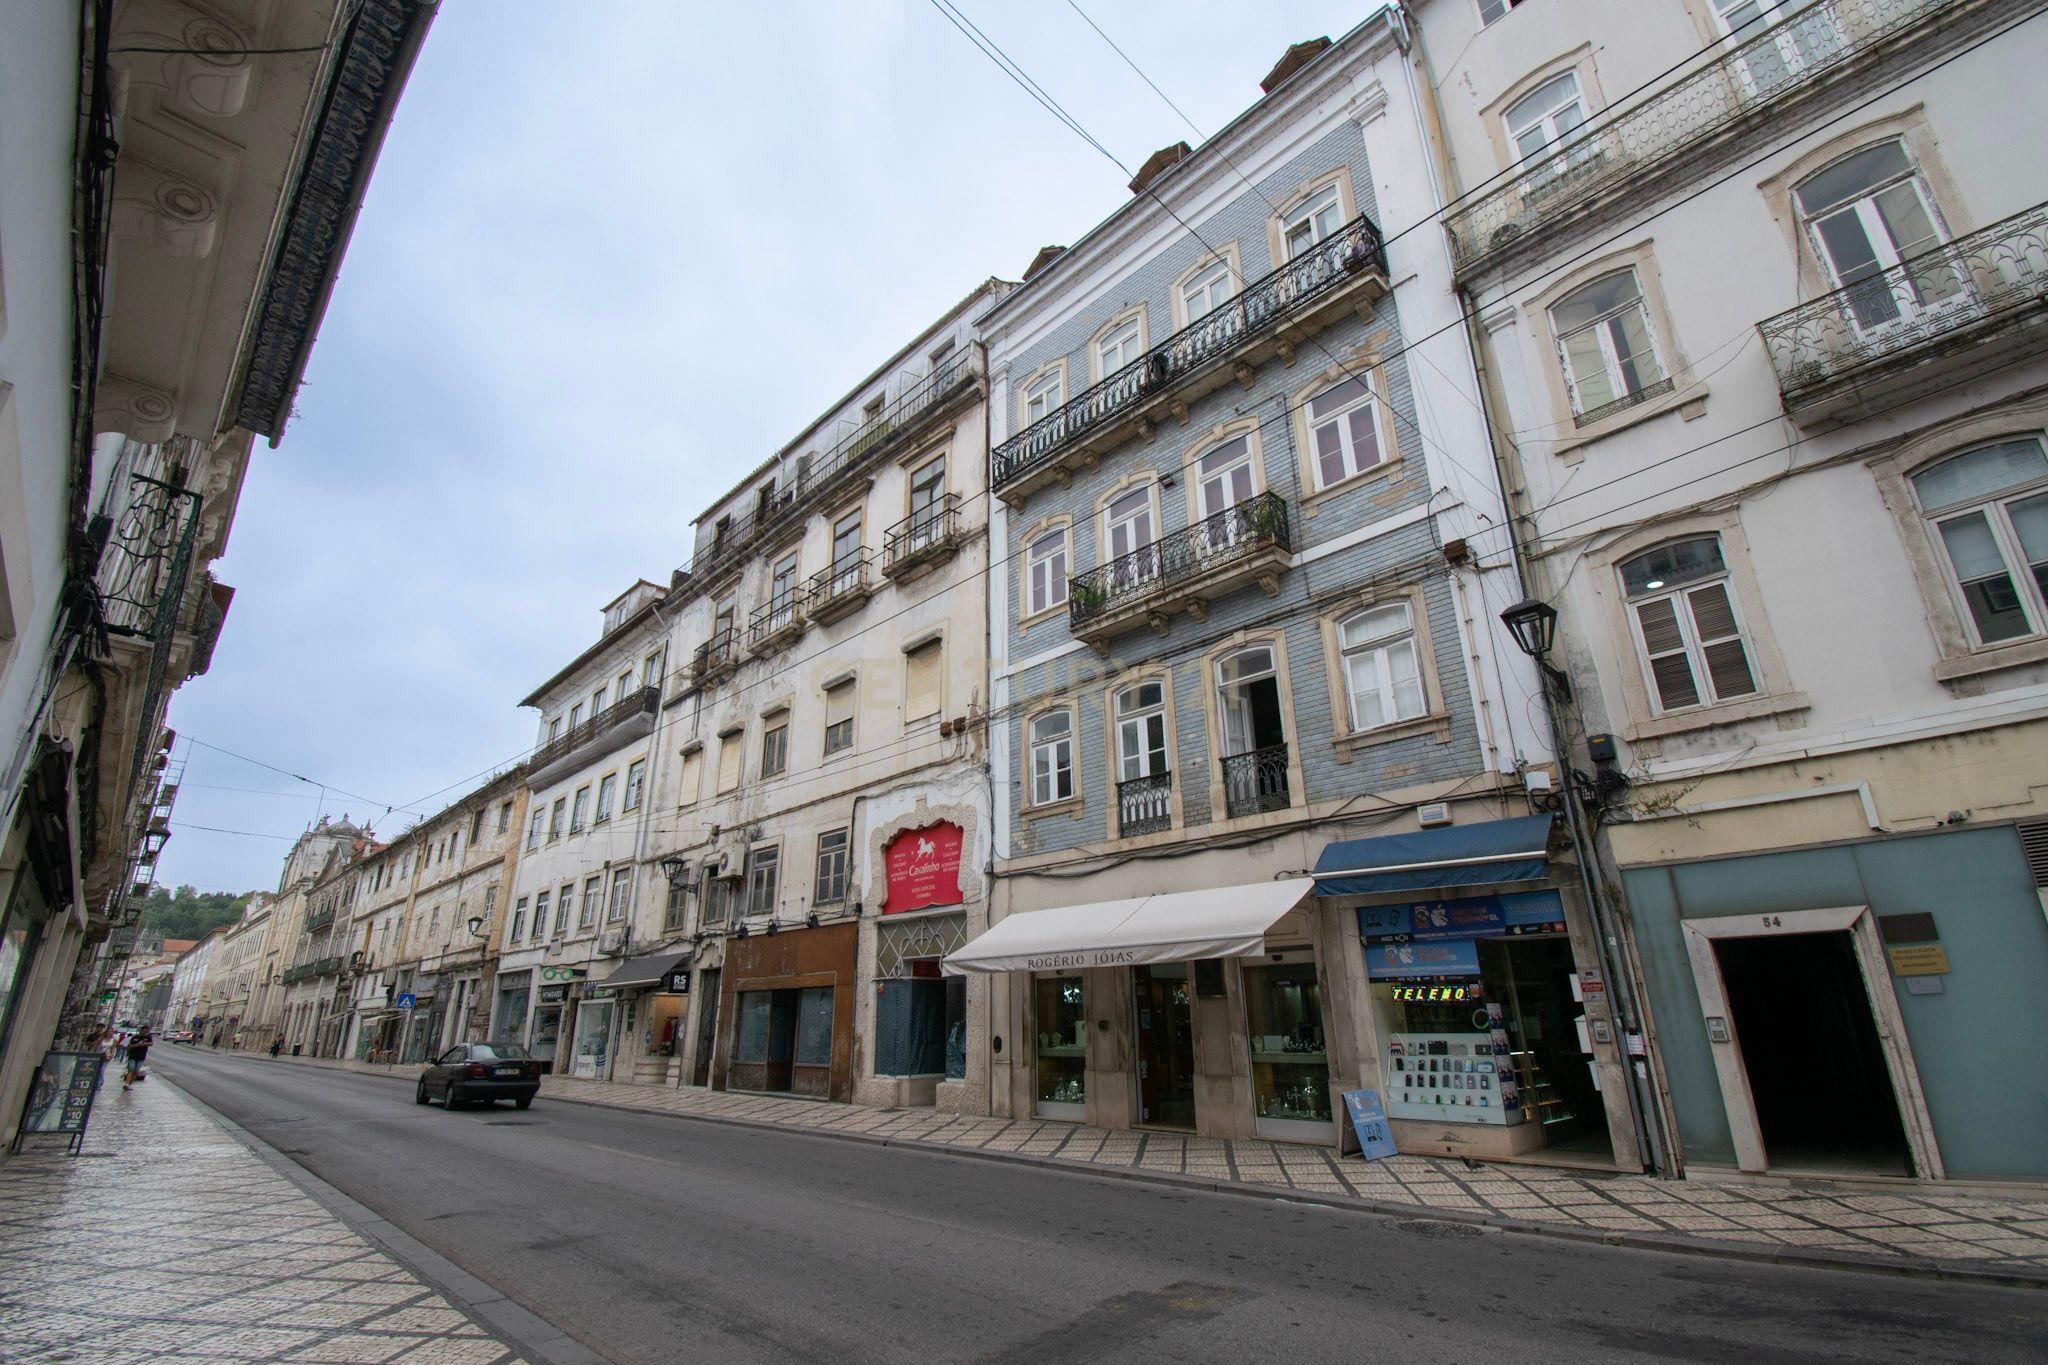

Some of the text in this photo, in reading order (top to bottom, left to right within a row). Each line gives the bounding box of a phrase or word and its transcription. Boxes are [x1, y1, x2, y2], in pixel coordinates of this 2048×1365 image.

[909, 862, 940, 876] Cavalinho
[1763, 916, 1781, 928] 54
[1028, 951, 1133, 968] ROGÉRIO JÓIAS
[673, 975, 687, 986] RS
[1392, 987, 1465, 1001] TELEMO
